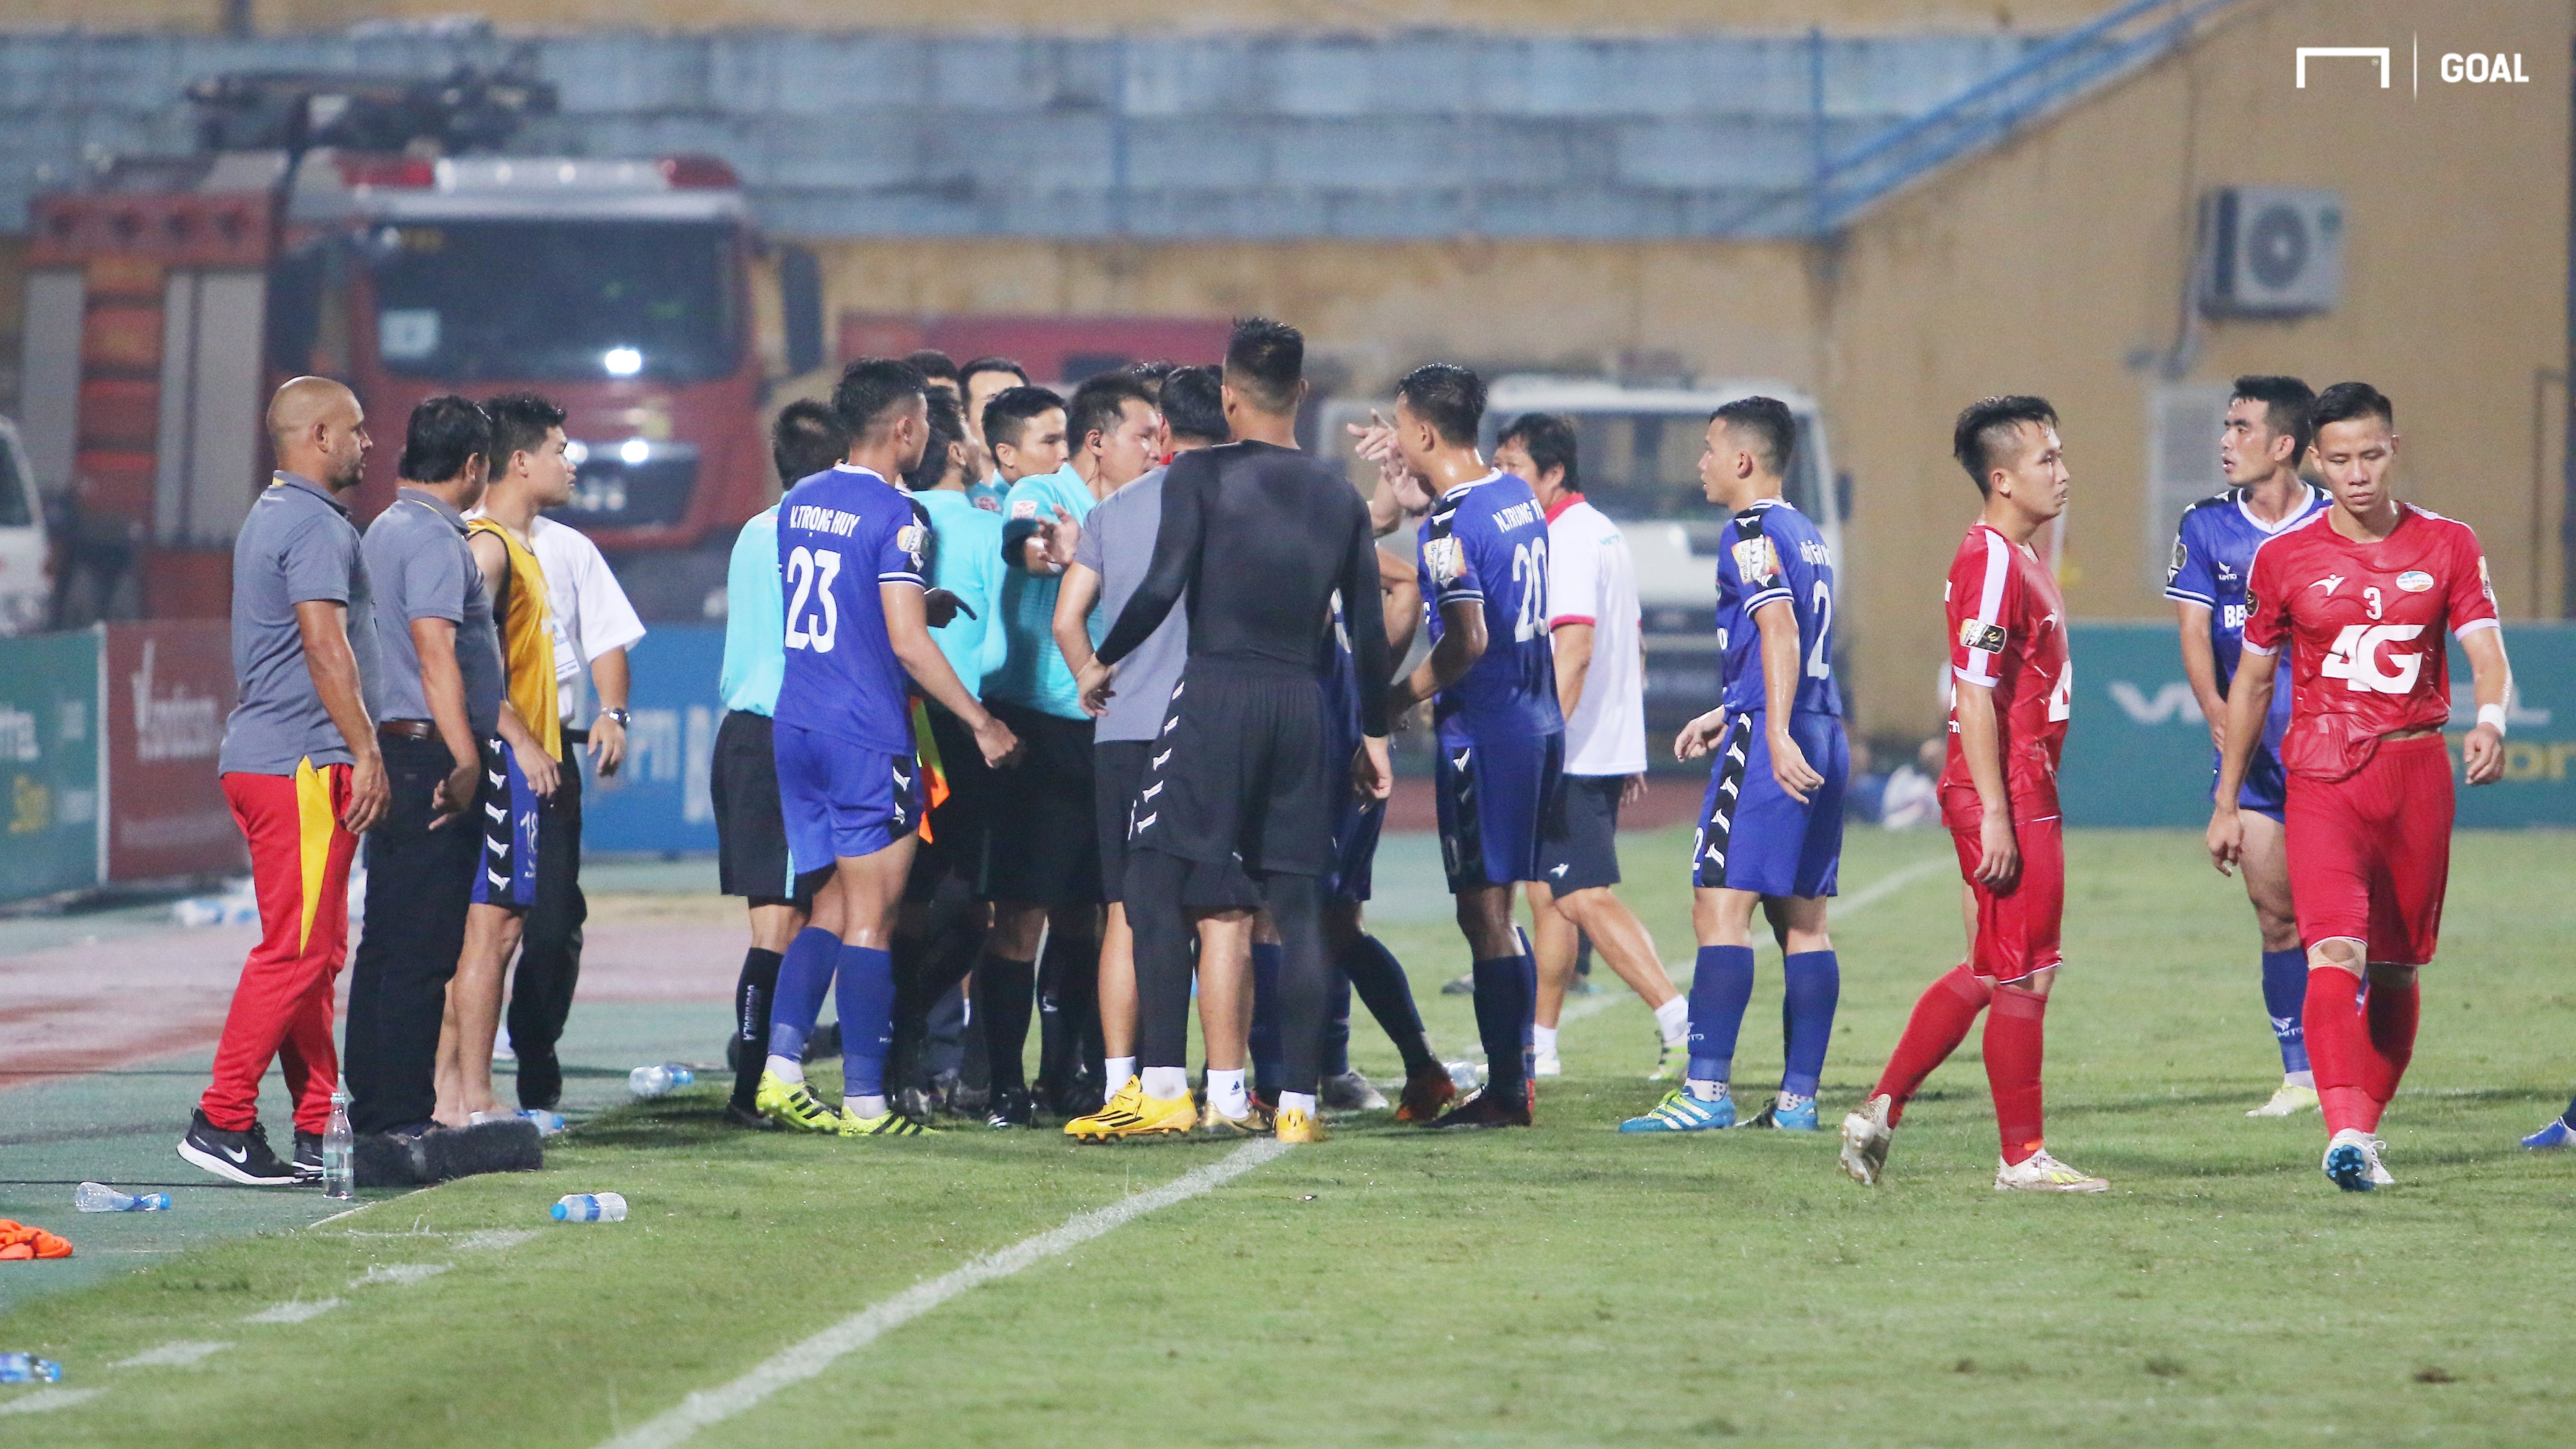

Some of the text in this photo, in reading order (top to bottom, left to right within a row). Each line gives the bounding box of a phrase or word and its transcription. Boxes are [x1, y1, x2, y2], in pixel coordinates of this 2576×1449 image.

[830, 510, 861, 538] HUY
[1492, 501, 1534, 533] N.TRUNG
[784, 545, 841, 654] 23
[1512, 536, 1549, 642] 20
[2363, 586, 2383, 620] 3
[2321, 624, 2426, 695] 4G
